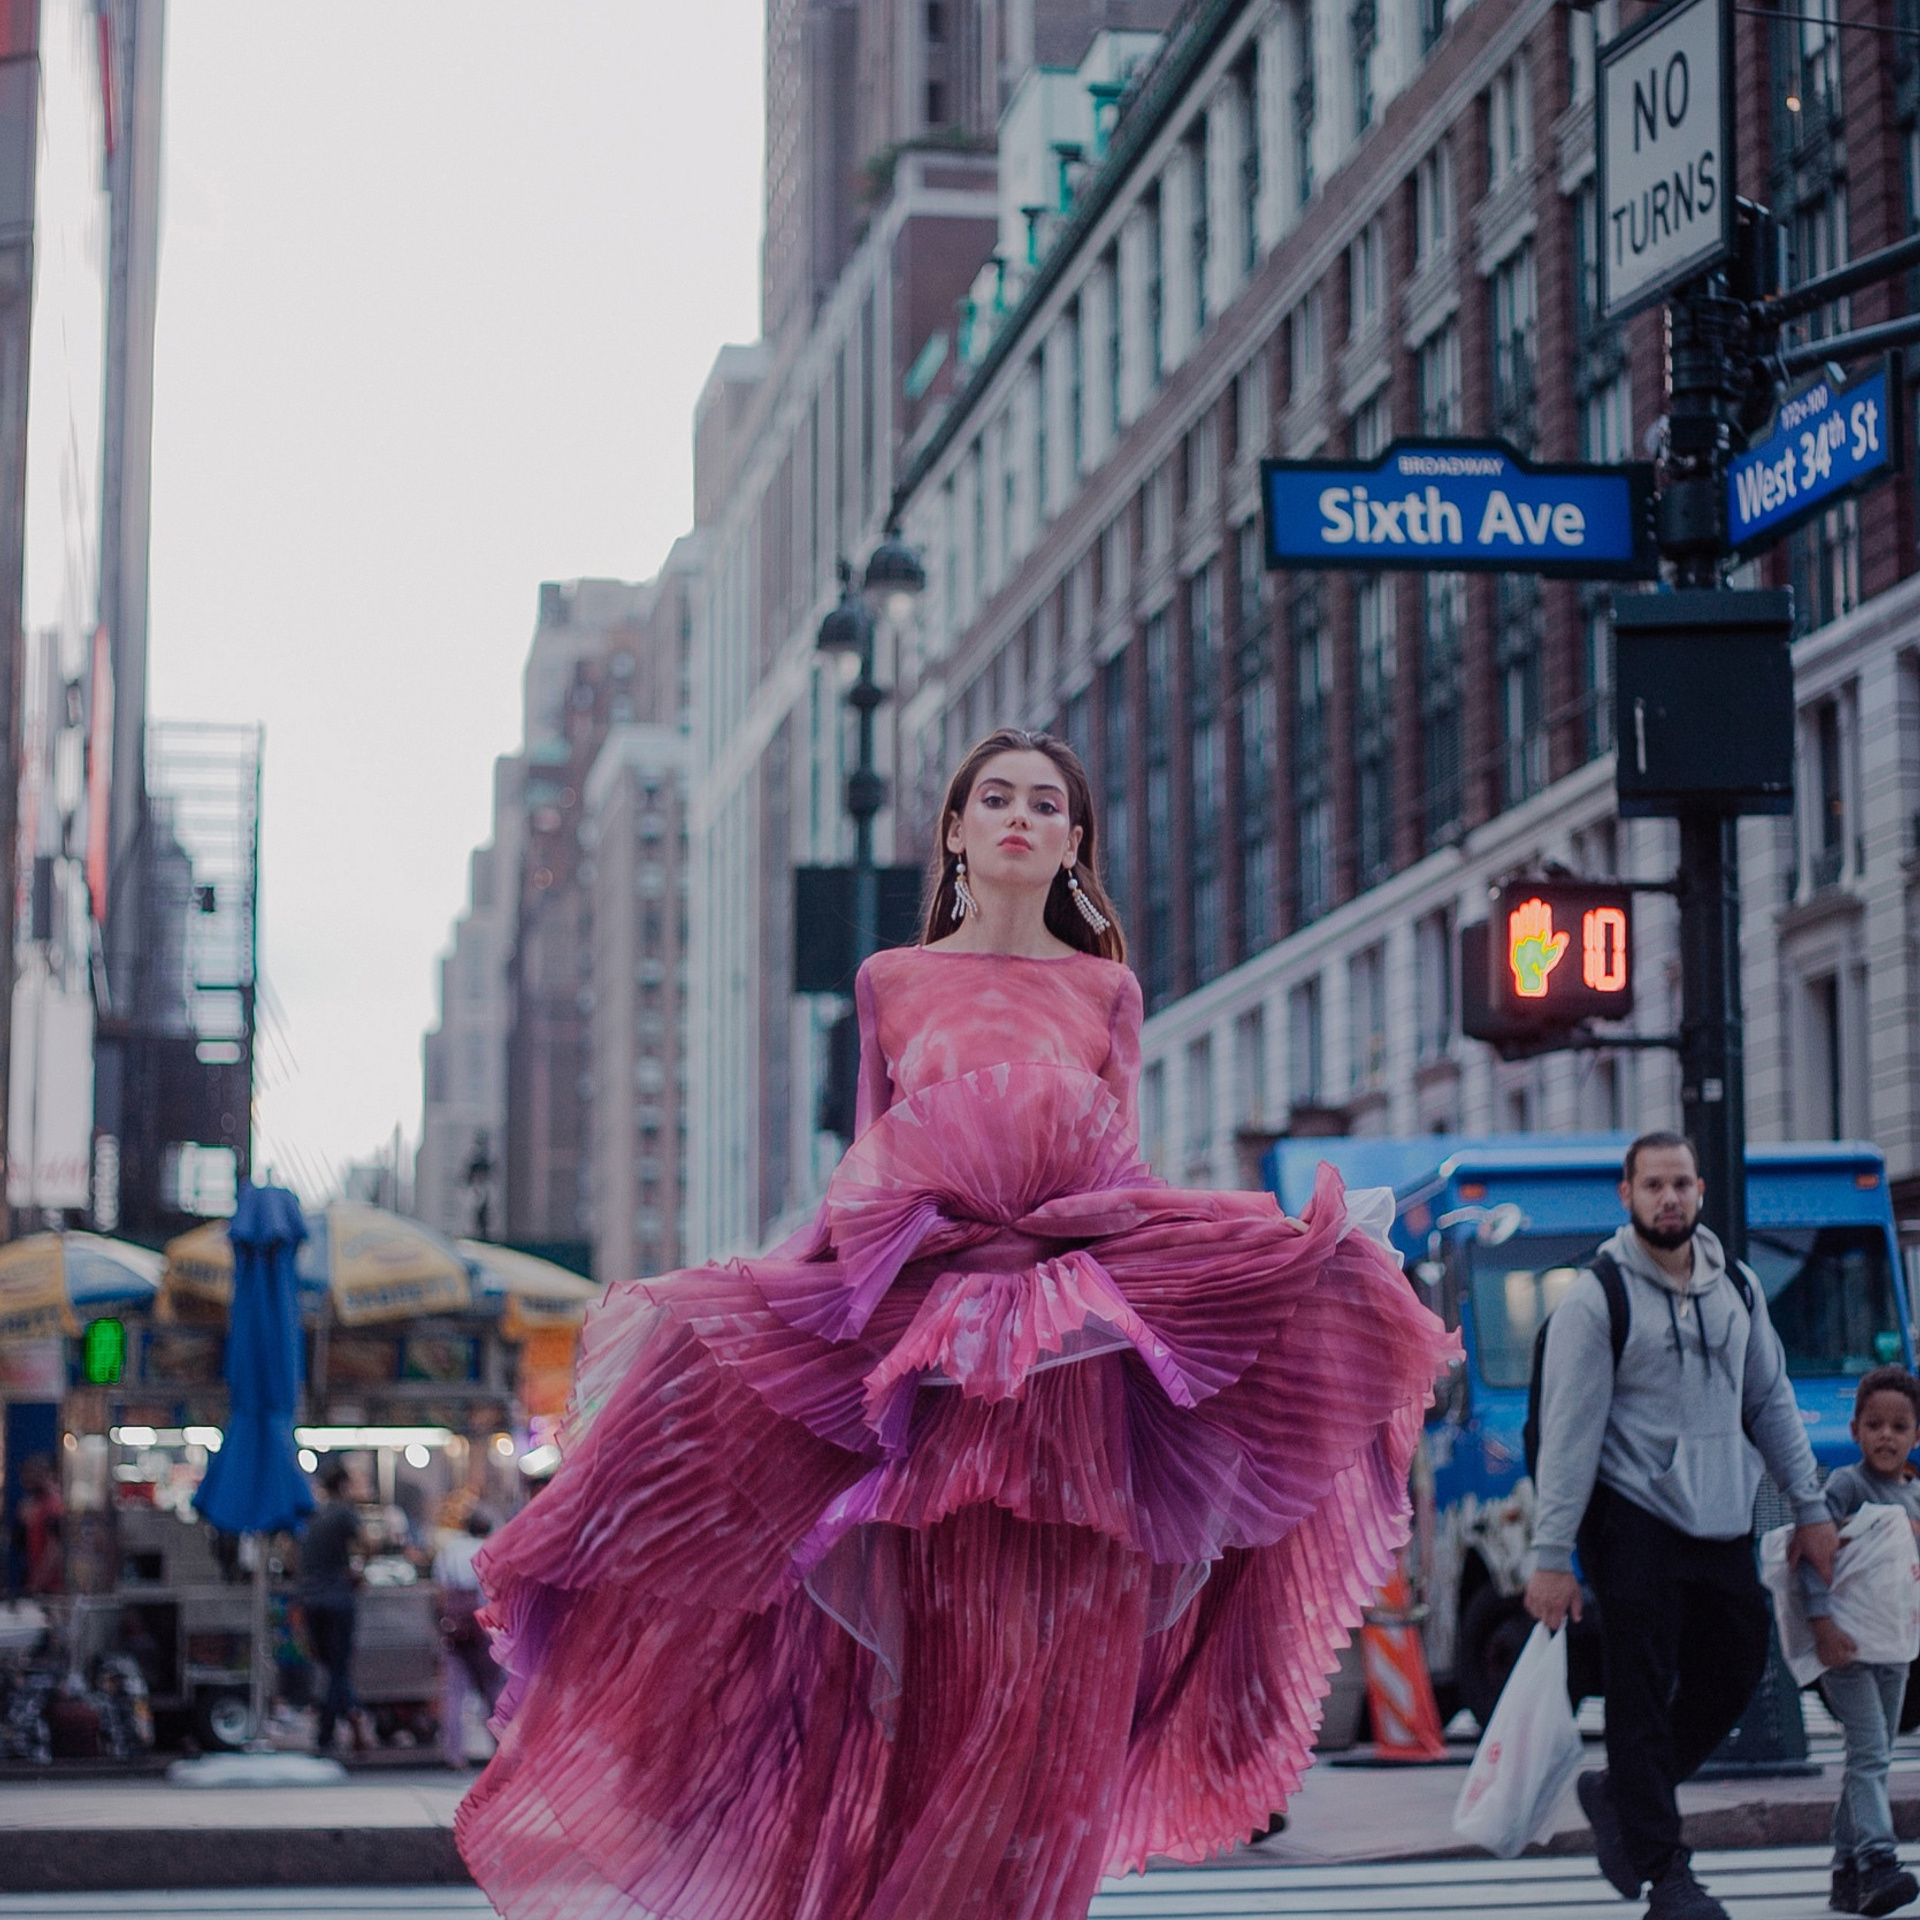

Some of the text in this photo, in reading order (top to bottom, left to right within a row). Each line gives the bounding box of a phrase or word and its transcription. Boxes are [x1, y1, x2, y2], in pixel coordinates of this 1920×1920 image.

[1634, 50, 1689, 152] NO
[1612, 150, 1716, 266] TURNS
[1399, 456, 1504, 476] BROADWAY
[1736, 398, 1879, 524] West 34th St
[1319, 486, 1586, 546] Sixth Ave
